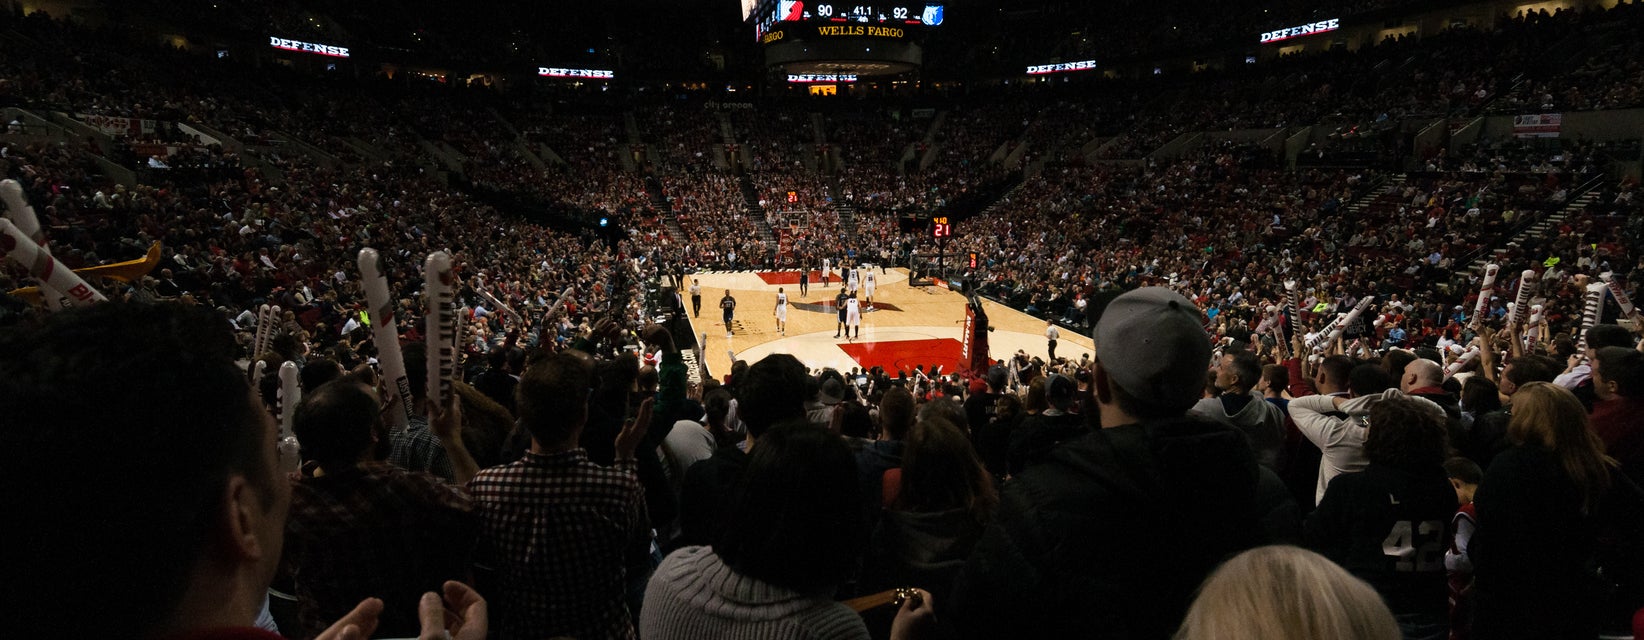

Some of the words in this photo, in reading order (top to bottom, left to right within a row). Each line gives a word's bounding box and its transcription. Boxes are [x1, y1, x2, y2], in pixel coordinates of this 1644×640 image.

[818, 5, 832, 16] 90
[853, 6, 872, 15] 41.1
[893, 8, 907, 19] 92
[818, 26, 864, 35] WELLS
[868, 26, 904, 38] FARGO
[1260, 19, 1339, 42] DEFENSE
[270, 36, 350, 57] DEFENSE
[538, 67, 614, 78] DEFENSE
[1026, 60, 1096, 74] DEFENSE
[935, 224, 949, 236] 21
[1382, 520, 1444, 572] 42
